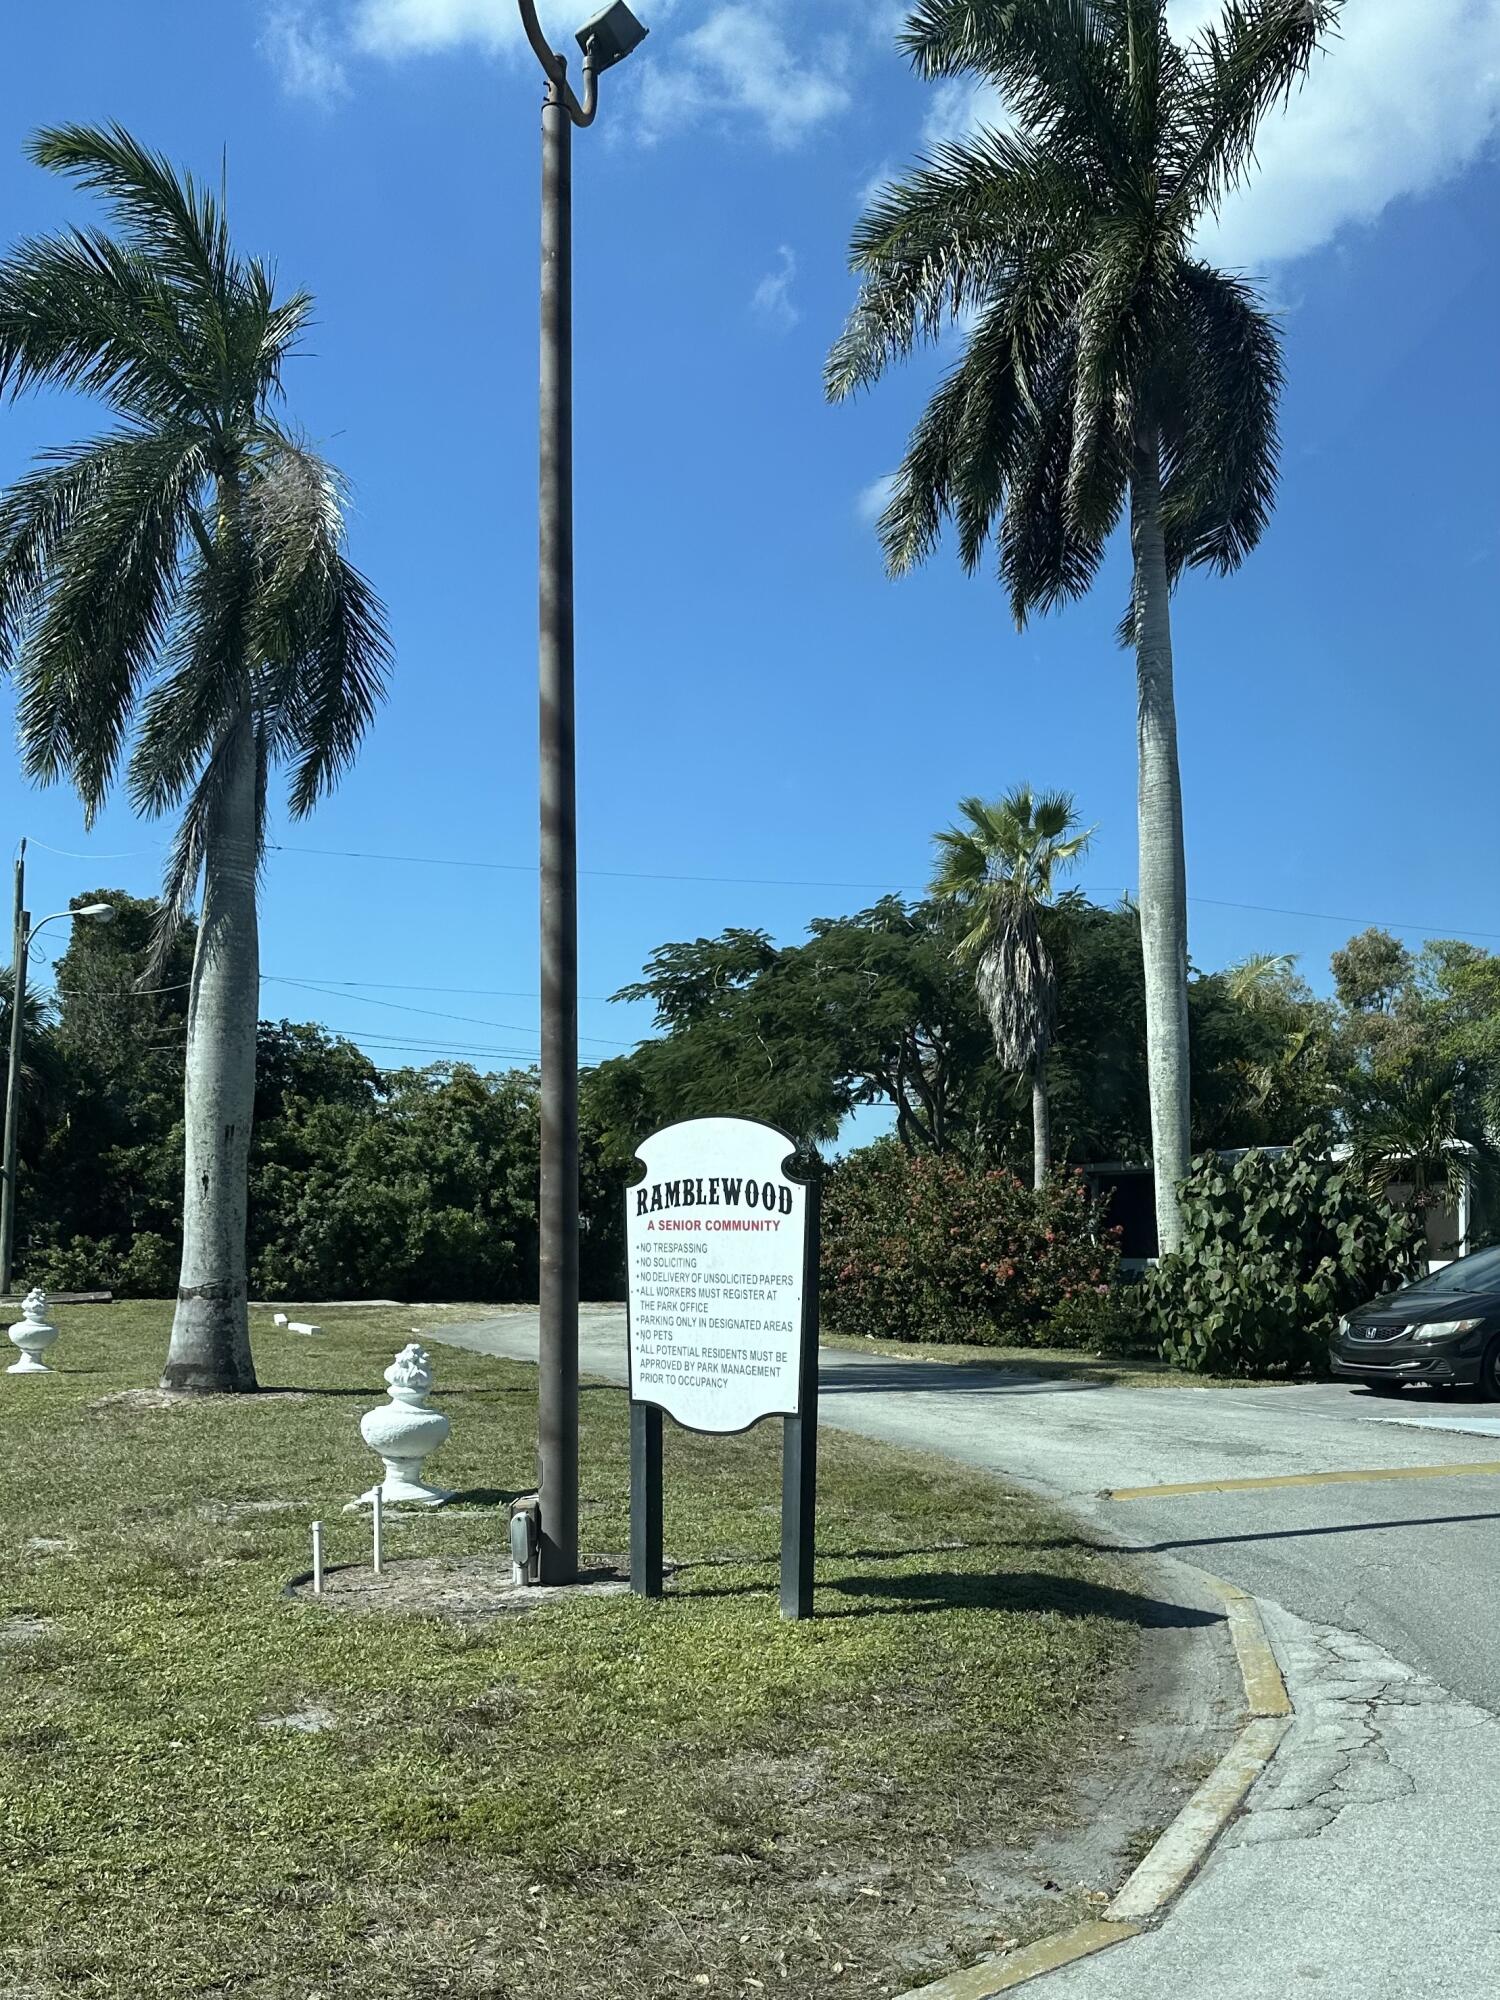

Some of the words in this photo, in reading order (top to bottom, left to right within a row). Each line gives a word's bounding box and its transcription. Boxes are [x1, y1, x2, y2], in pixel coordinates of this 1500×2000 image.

[636, 1178, 793, 1216] RAMBLEWOOD
[647, 1220, 655, 1231] A
[658, 1220, 702, 1231] SENIOR
[705, 1220, 781, 1232] COMMUNITY
[640, 1242, 652, 1253] NO
[653, 1242, 708, 1254] TRESPASSING
[640, 1257, 652, 1267] NO
[653, 1257, 697, 1268] SOLICITING
[640, 1271, 652, 1282] NO
[652, 1272, 690, 1283] DELIVERY
[691, 1273, 702, 1283] OF
[703, 1273, 758, 1285] UNSOLICITED
[759, 1274, 794, 1286] PAPERS
[640, 1286, 655, 1297] ALL
[656, 1286, 697, 1298] WORKERS
[698, 1287, 721, 1299] MUST
[723, 1288, 765, 1300] REGISTER
[766, 1290, 777, 1301] AT
[640, 1300, 655, 1311] THE
[657, 1301, 678, 1312] PARK
[680, 1302, 709, 1313] OFFICE
[640, 1314, 675, 1327] PARKING
[676, 1316, 697, 1328] ONLY
[699, 1317, 707, 1328] IN
[708, 1317, 762, 1331] DESIGNATED
[763, 1320, 793, 1333] AREAS
[640, 1329, 652, 1340] NO
[653, 1330, 673, 1341] PETS
[640, 1344, 654, 1355] ALL
[656, 1344, 700, 1357] POTENTIAL
[702, 1347, 748, 1361] RESIDENTS
[749, 1350, 774, 1362] MUST
[775, 1351, 788, 1363] BE
[640, 1358, 682, 1371] APPROVED
[684, 1360, 695, 1372] BY
[697, 1361, 719, 1374] PARK
[720, 1363, 781, 1378] MANAGEMENT
[640, 1372, 664, 1384] PRIOR
[665, 1374, 676, 1385] TO
[678, 1375, 728, 1389] OCCUPANCY
